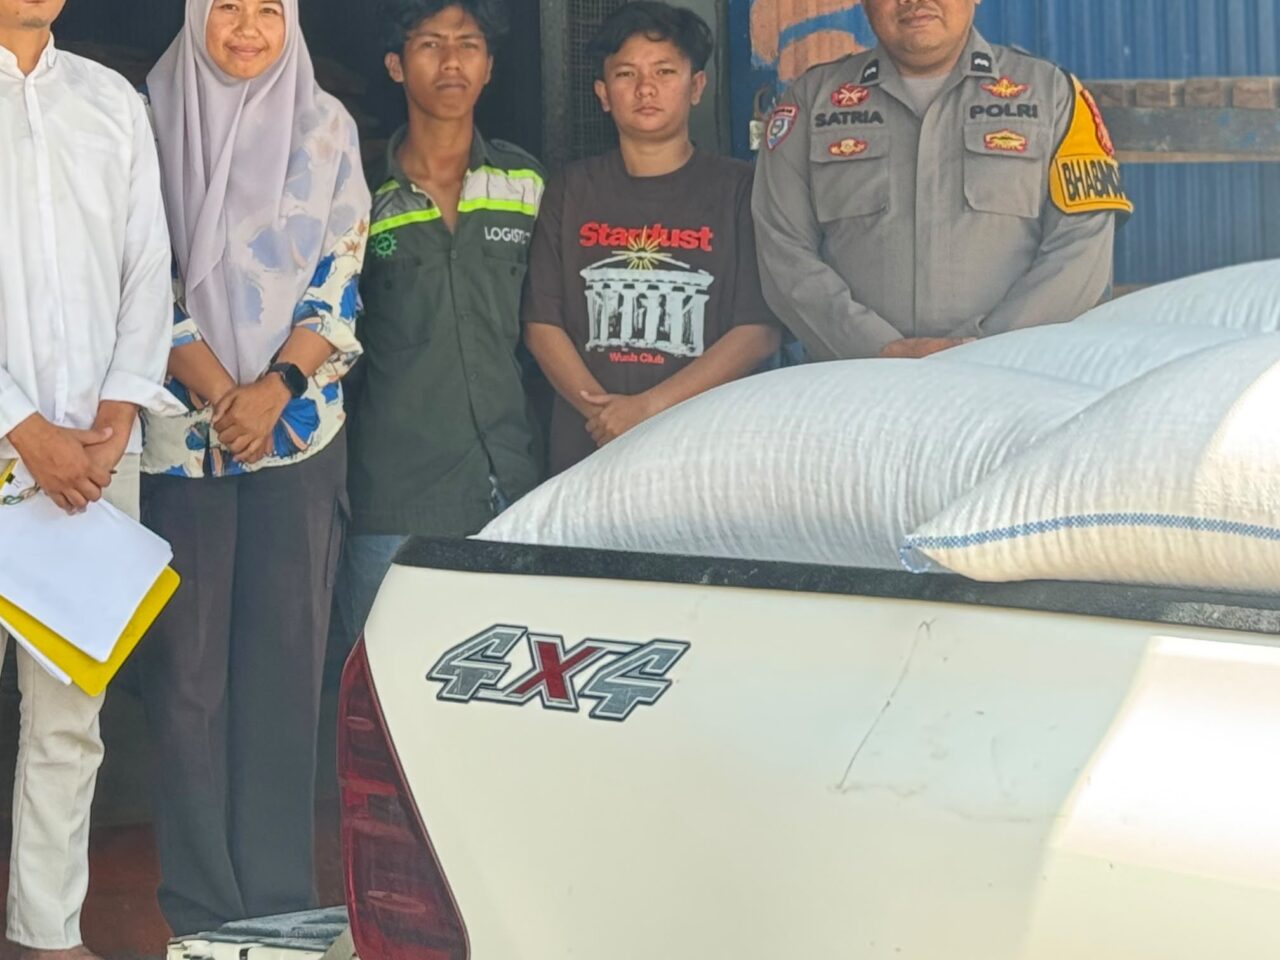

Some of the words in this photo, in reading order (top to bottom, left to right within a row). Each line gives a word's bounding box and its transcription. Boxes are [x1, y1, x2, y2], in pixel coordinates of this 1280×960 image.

[814, 110, 883, 127] SATRIA
[970, 104, 1037, 119] POLRI
[580, 221, 713, 251] Stardust
